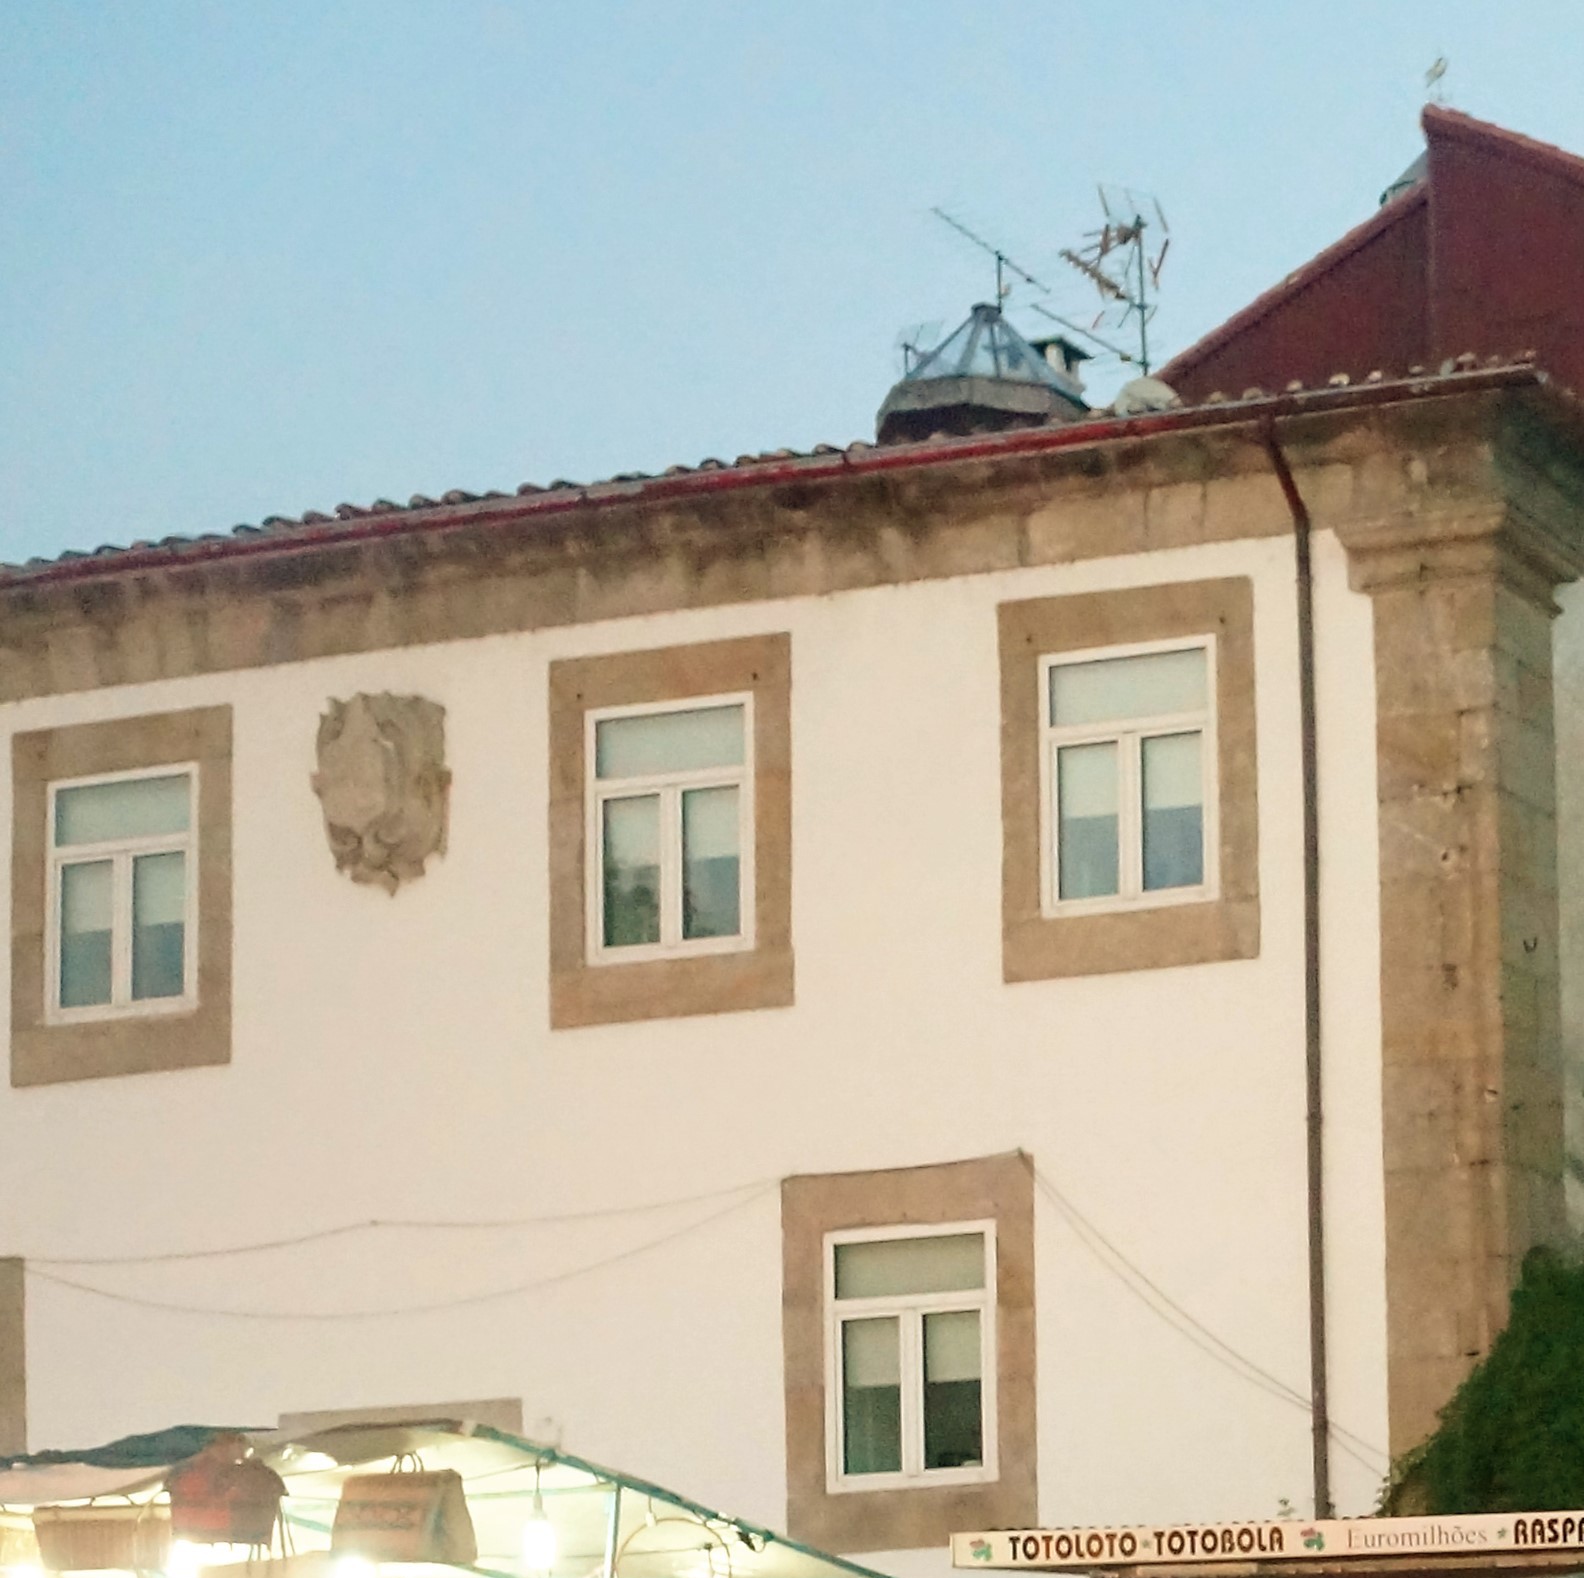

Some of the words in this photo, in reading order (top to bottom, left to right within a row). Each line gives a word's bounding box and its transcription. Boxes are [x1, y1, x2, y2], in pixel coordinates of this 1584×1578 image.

[1008, 1531, 1138, 1560] TOTOLOTO
[1153, 1526, 1285, 1556] TOTOBOLA
[1348, 1525, 1488, 1549] Euromilhões
